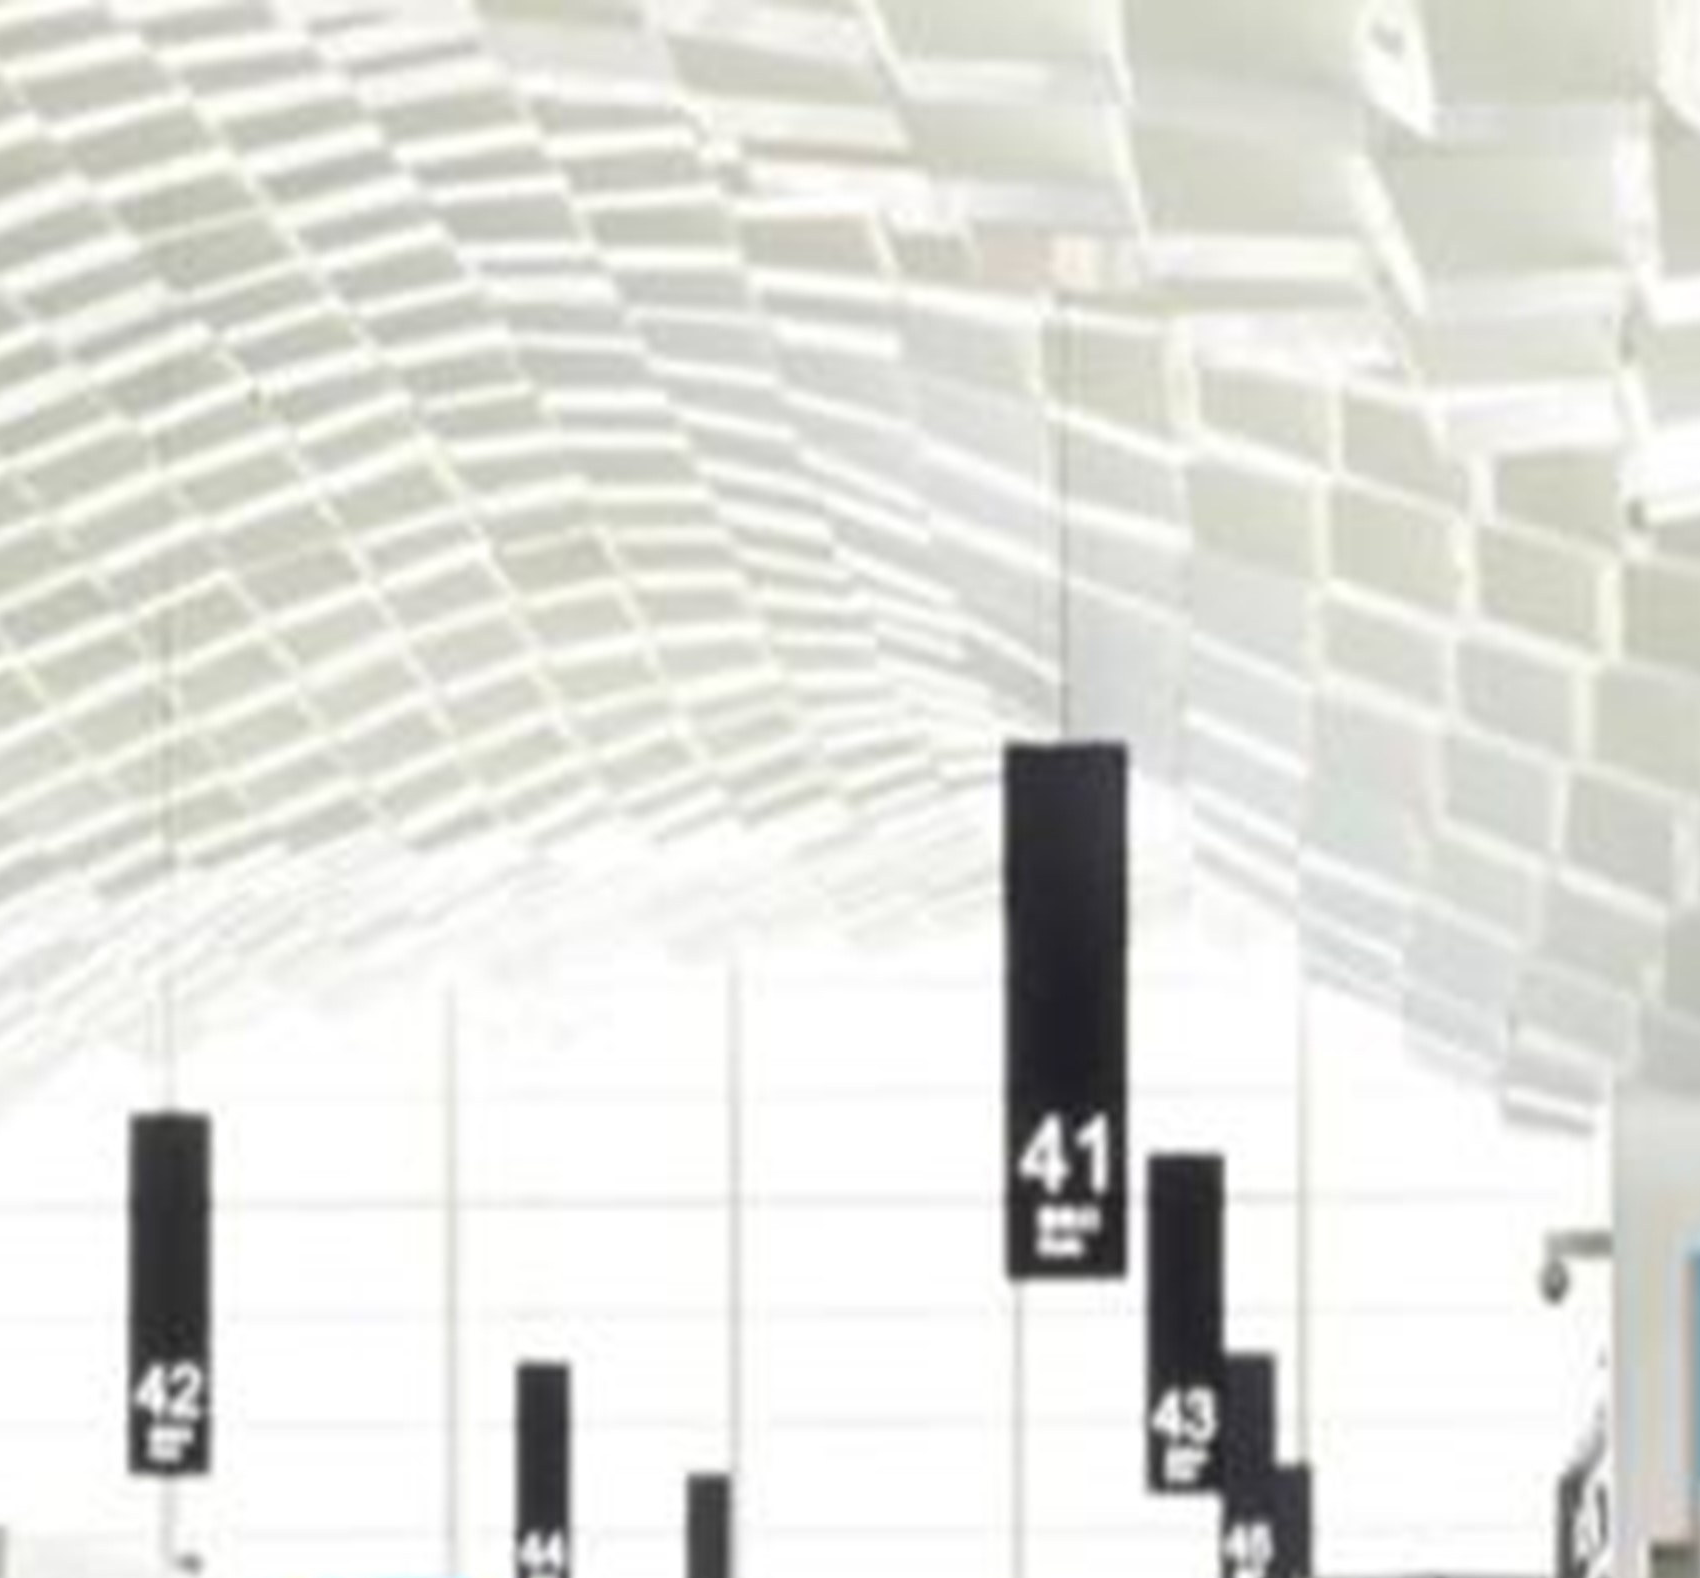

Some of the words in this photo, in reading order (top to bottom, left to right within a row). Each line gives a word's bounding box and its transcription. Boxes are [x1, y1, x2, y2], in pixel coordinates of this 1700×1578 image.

[1018, 1113, 1109, 1194] 41
[135, 1362, 203, 1419] 42
[1151, 1387, 1217, 1442] 43
